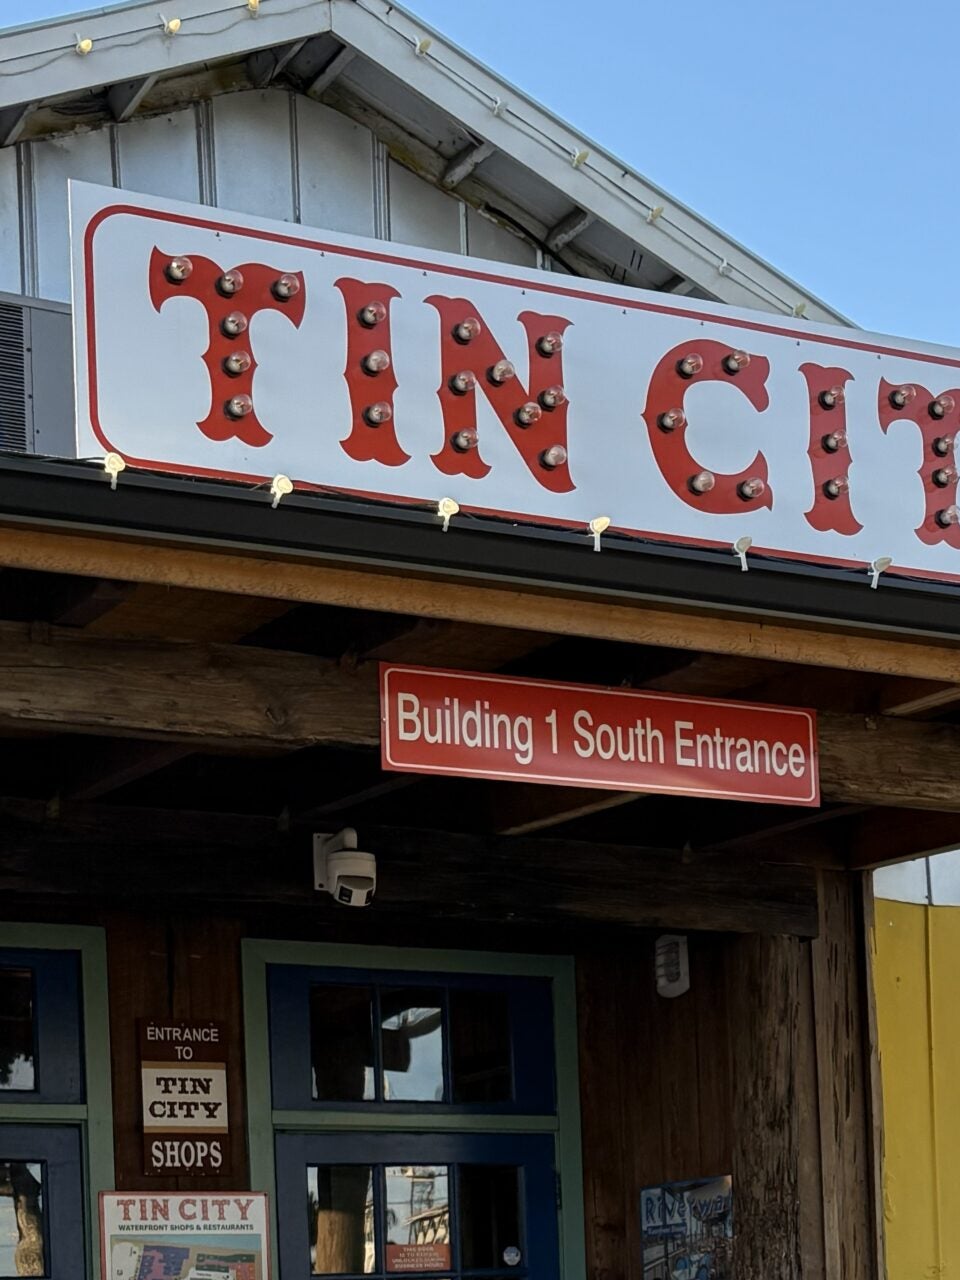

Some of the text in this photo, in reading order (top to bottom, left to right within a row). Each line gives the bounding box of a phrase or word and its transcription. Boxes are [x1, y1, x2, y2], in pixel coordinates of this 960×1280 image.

[148, 244, 577, 494] TIN
[397, 692, 806, 778] Building 1 South Entrance
[147, 1026, 219, 1042] ENTRANCE
[175, 1046, 193, 1060] TO
[156, 1077, 213, 1094] TIN
[149, 1101, 222, 1118] CITY
[151, 1141, 222, 1168] SHOPS
[116, 1199, 254, 1221] TIN CITY
